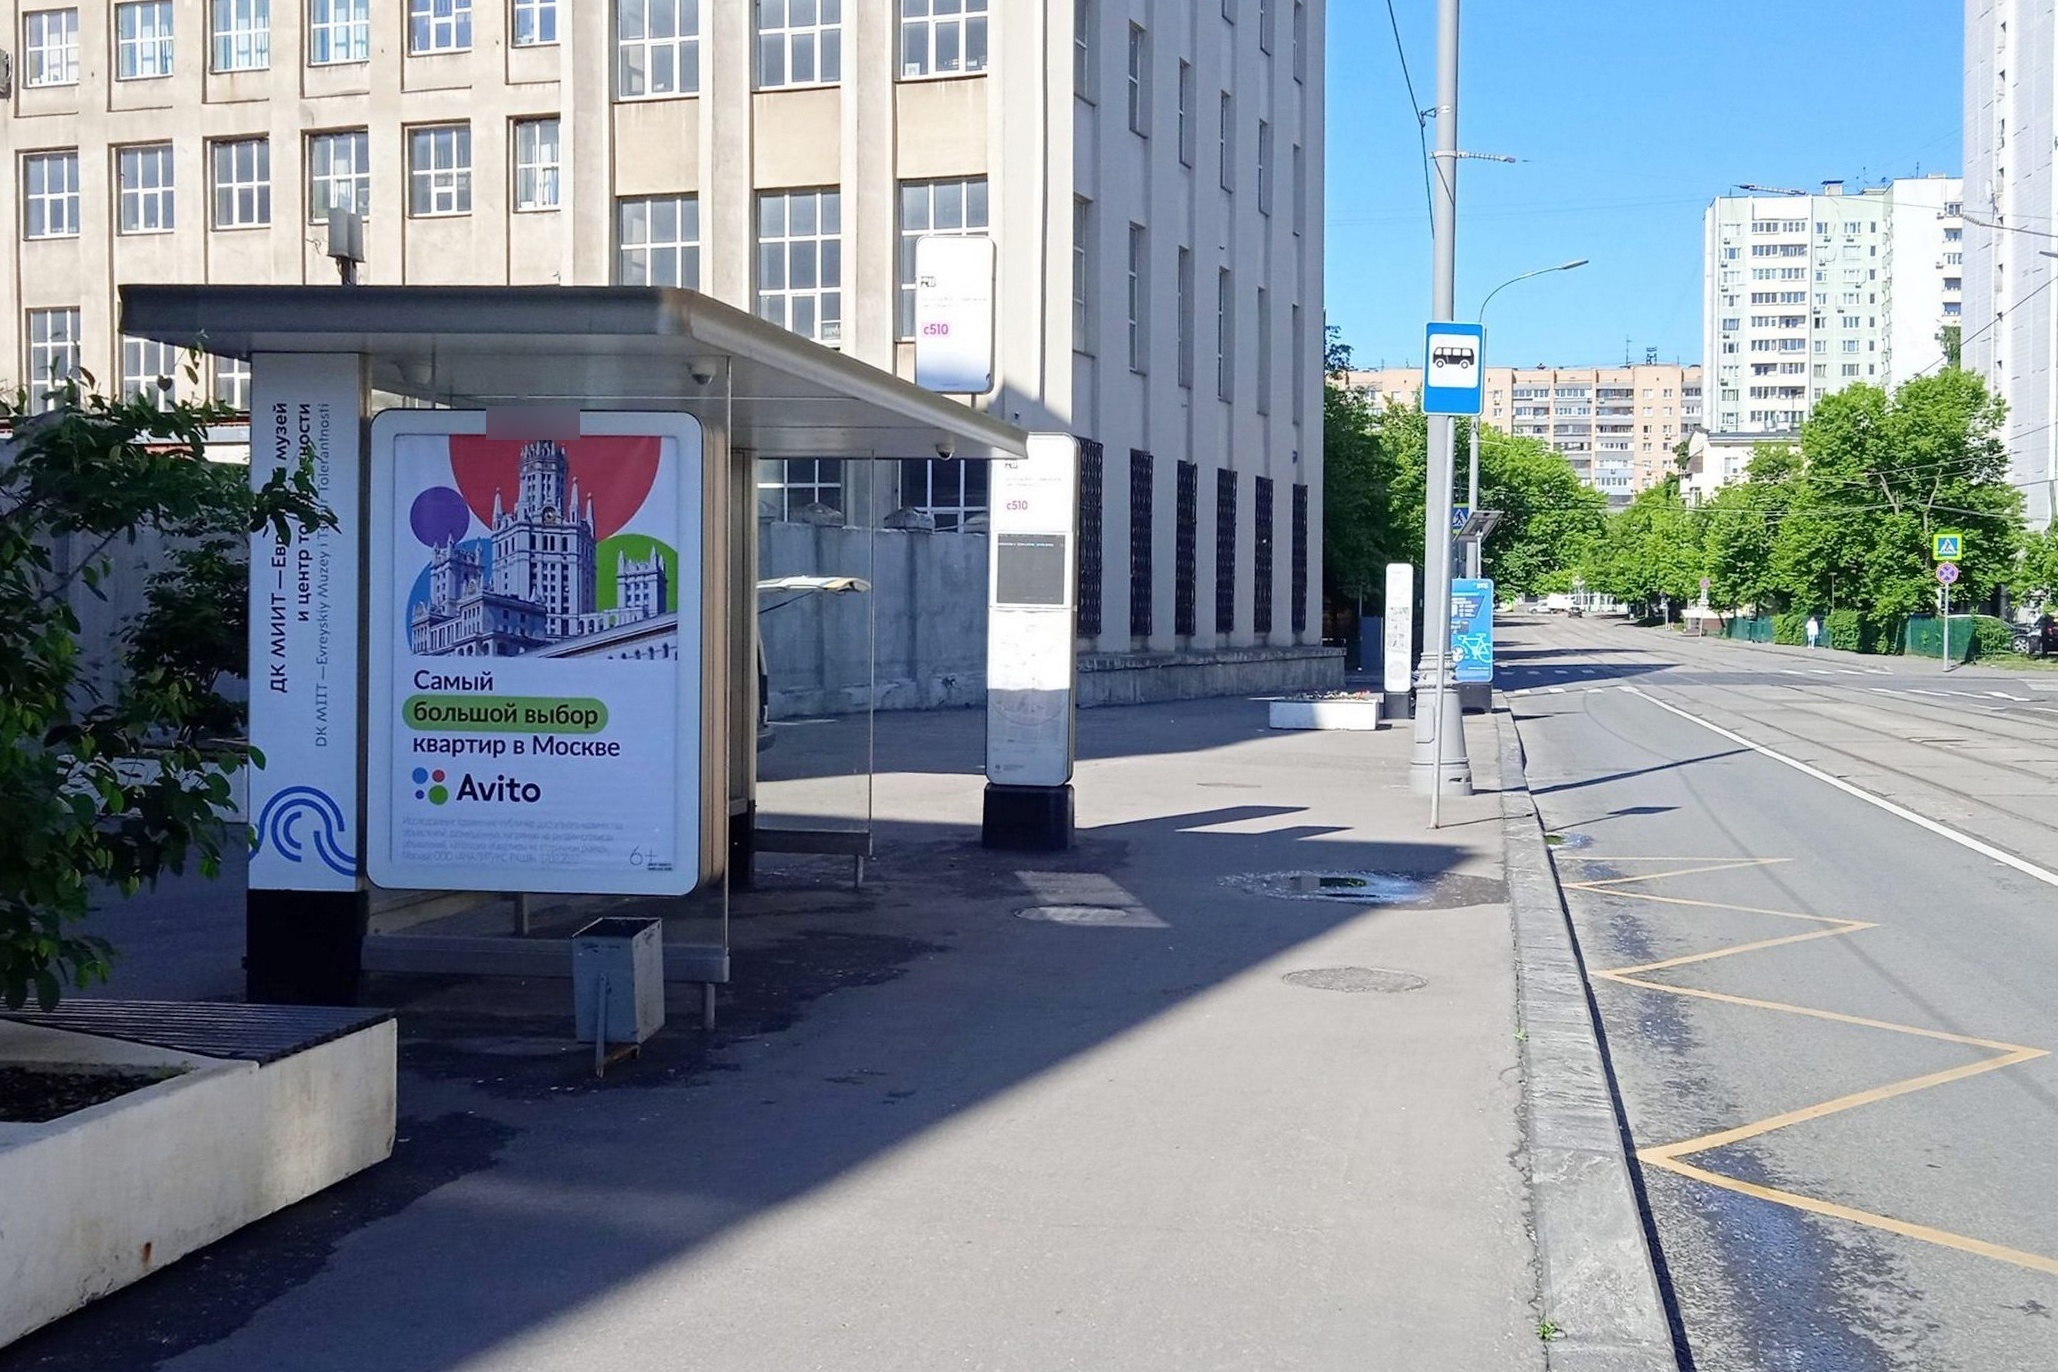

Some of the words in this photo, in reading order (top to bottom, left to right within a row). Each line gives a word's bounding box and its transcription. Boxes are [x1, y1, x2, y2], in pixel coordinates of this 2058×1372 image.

[273, 402, 290, 460] музей
[317, 402, 329, 492] Tolerantnosti
[297, 549, 312, 605] центр
[316, 551, 332, 598] Muzey
[270, 592, 286, 658] МИИТ
[298, 611, 309, 622] и
[315, 601, 331, 665] Evreyskiy
[270, 664, 288, 693] ДК
[413, 669, 494, 691] Самый
[315, 682, 328, 723] MIIT
[413, 701, 518, 723] большой
[524, 704, 598, 728] выбор
[315, 725, 327, 747] DK
[412, 736, 506, 758] квартир
[513, 740, 525, 755] в
[532, 736, 621, 756] Москве
[456, 773, 541, 802] Avito
[629, 844, 658, 866] 6+
